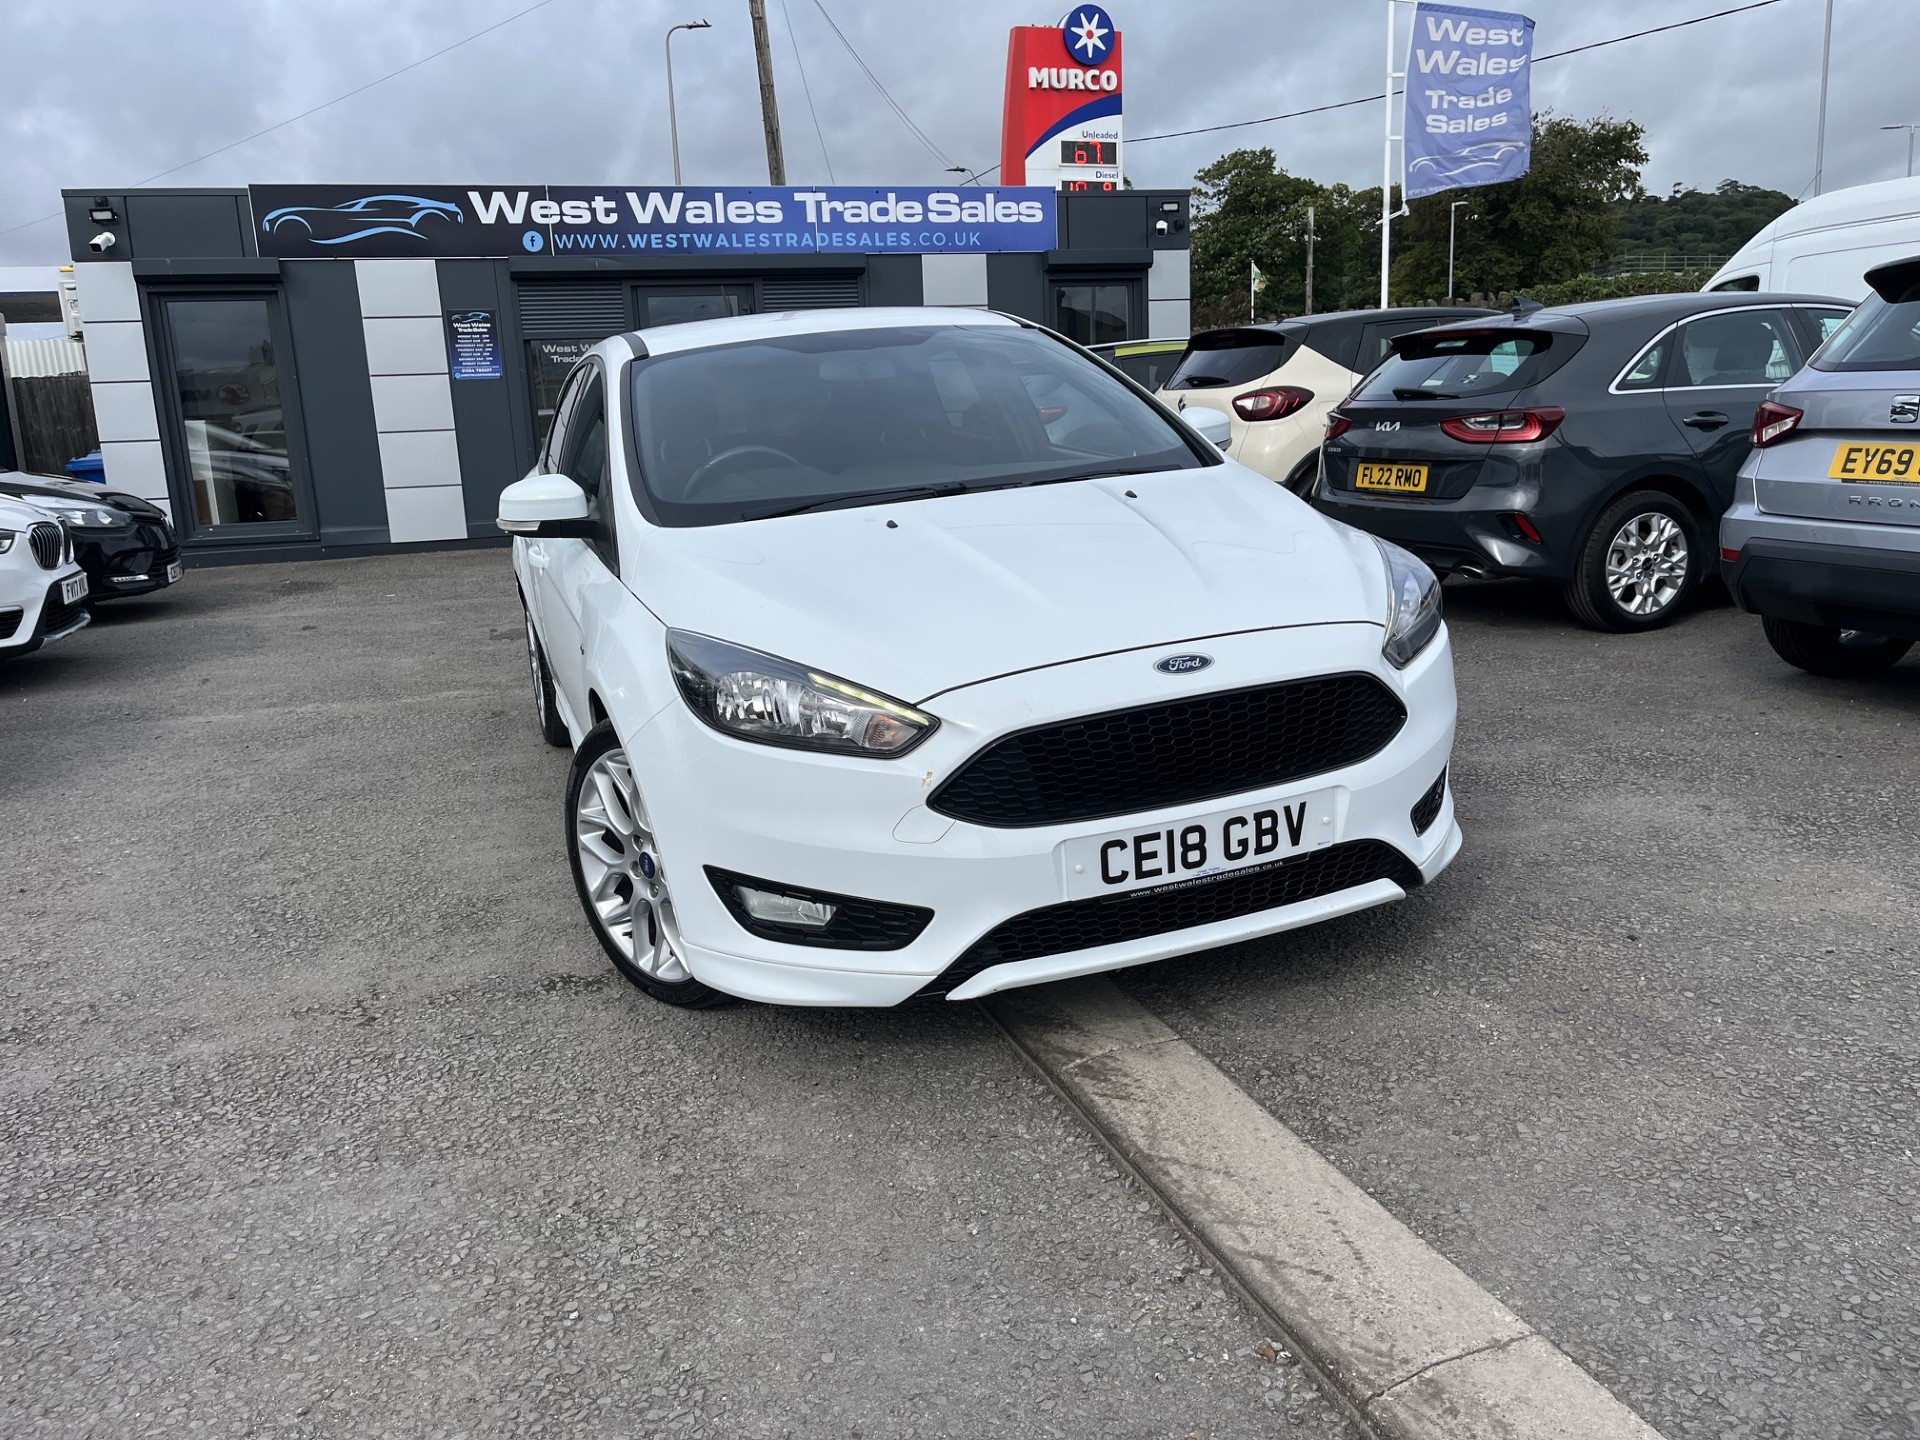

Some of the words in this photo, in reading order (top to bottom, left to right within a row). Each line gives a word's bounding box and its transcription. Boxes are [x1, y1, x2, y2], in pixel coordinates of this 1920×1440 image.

[1426, 16, 1524, 46] West
[1416, 49, 1527, 75] Wales
[1028, 67, 1117, 91] MURCO
[1425, 86, 1512, 109] Trade
[1425, 112, 1508, 133] Sales
[1082, 130, 1118, 139] Unleaded
[1095, 171, 1118, 179] Diesel
[467, 191, 618, 224] West
[625, 192, 783, 224] Wales
[794, 192, 923, 223] Trade
[928, 192, 1043, 223] Sales
[554, 232, 981, 249] WWW.WESTWALESTRADESALES.CO.UK
[542, 344, 577, 353] West
[1375, 421, 1400, 431] KIA
[1841, 447, 1914, 475] EY69
[1361, 467, 1392, 485] FL22
[1394, 469, 1421, 488] RMO
[1168, 656, 1201, 671] Ford
[1100, 824, 1207, 885] CE18
[1223, 801, 1307, 861] GBV
